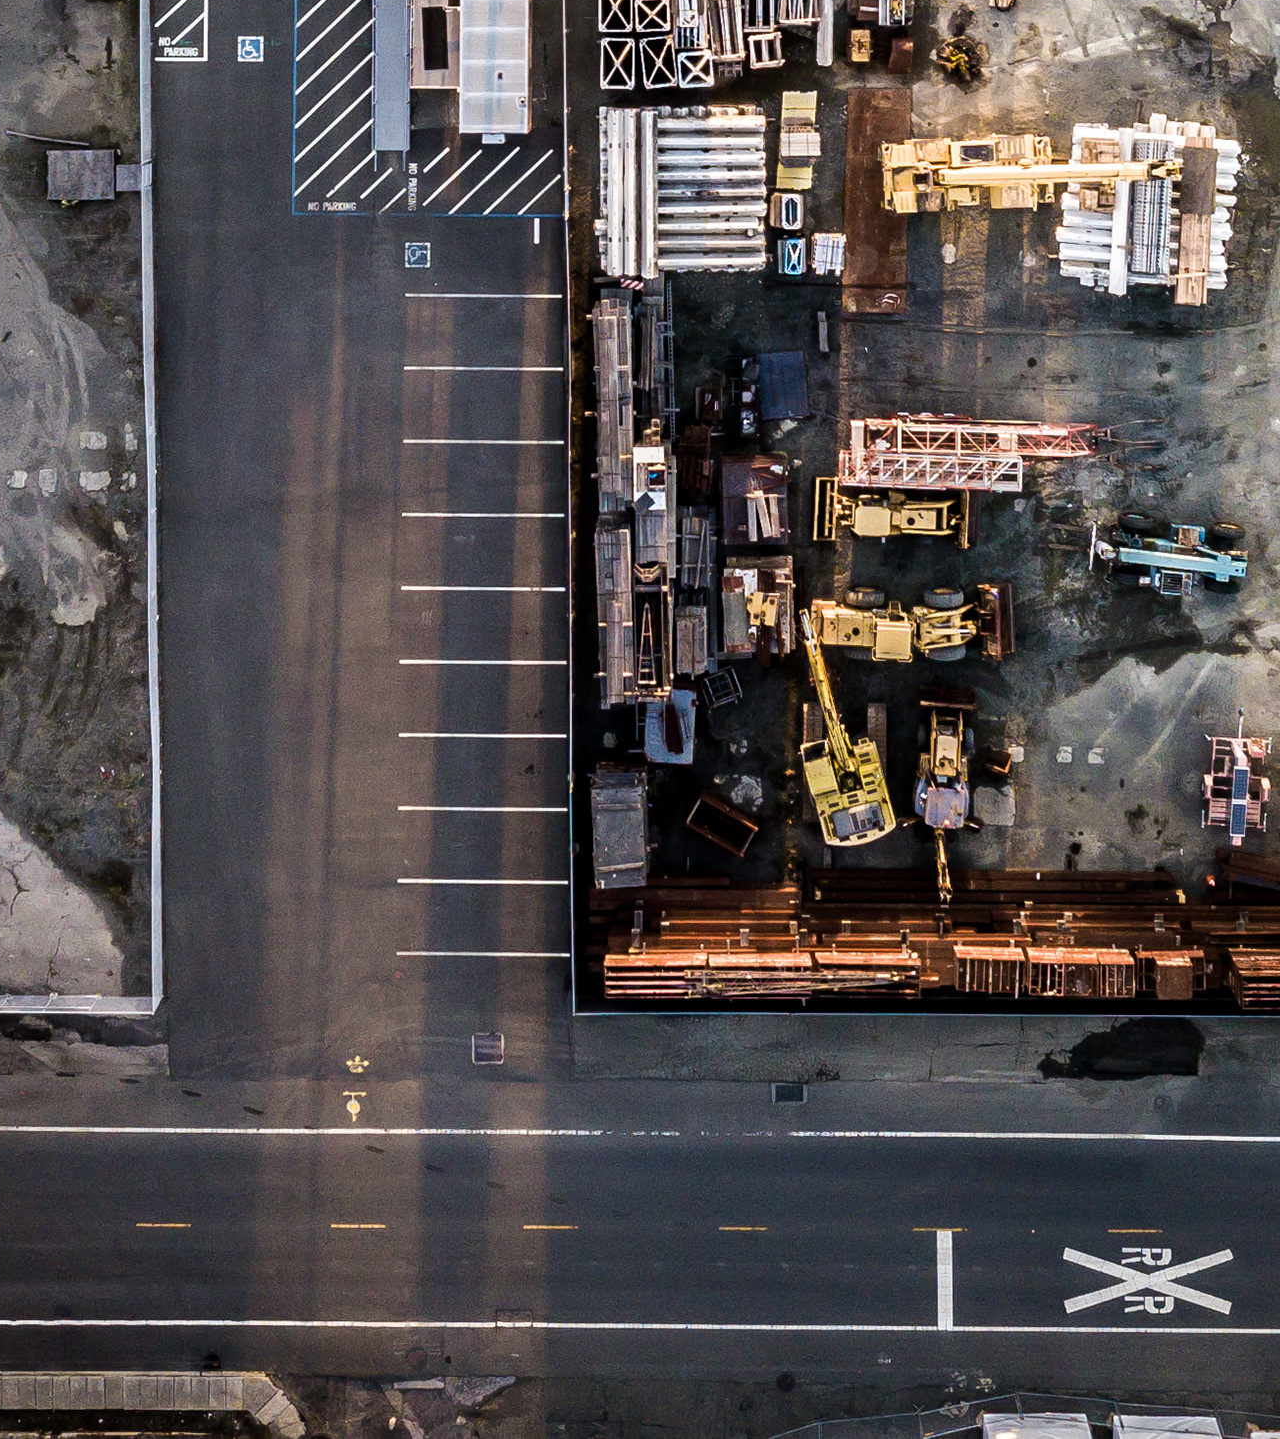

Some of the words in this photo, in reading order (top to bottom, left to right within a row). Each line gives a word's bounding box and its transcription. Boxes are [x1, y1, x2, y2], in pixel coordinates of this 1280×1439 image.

[159, 37, 171, 47] NO
[163, 47, 199, 57] PARKING
[408, 163, 419, 175] NO
[408, 177, 418, 212] PARKING
[308, 202, 320, 211] NO
[323, 202, 357, 212] PARKING
